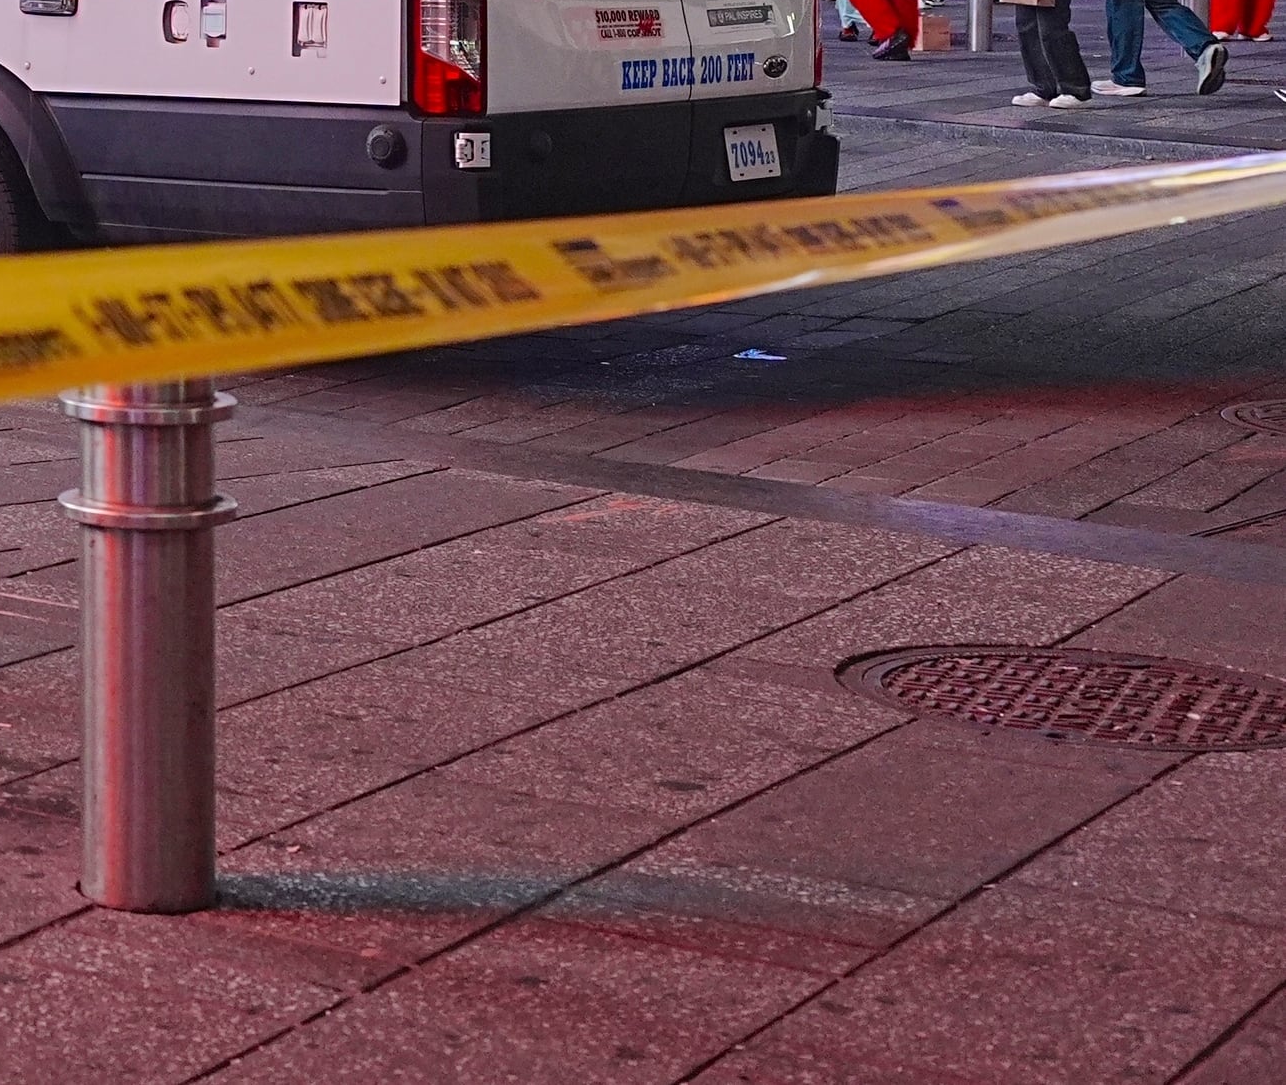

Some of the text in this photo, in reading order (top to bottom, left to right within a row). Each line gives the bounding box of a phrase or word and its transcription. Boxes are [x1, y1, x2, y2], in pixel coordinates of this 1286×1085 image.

[595, 9, 660, 24] $10,000 REWARD
[600, 29, 612, 39] CALL
[621, 52, 755, 90] KEEP BACK 200 FEET
[731, 140, 775, 168] 7094 23
